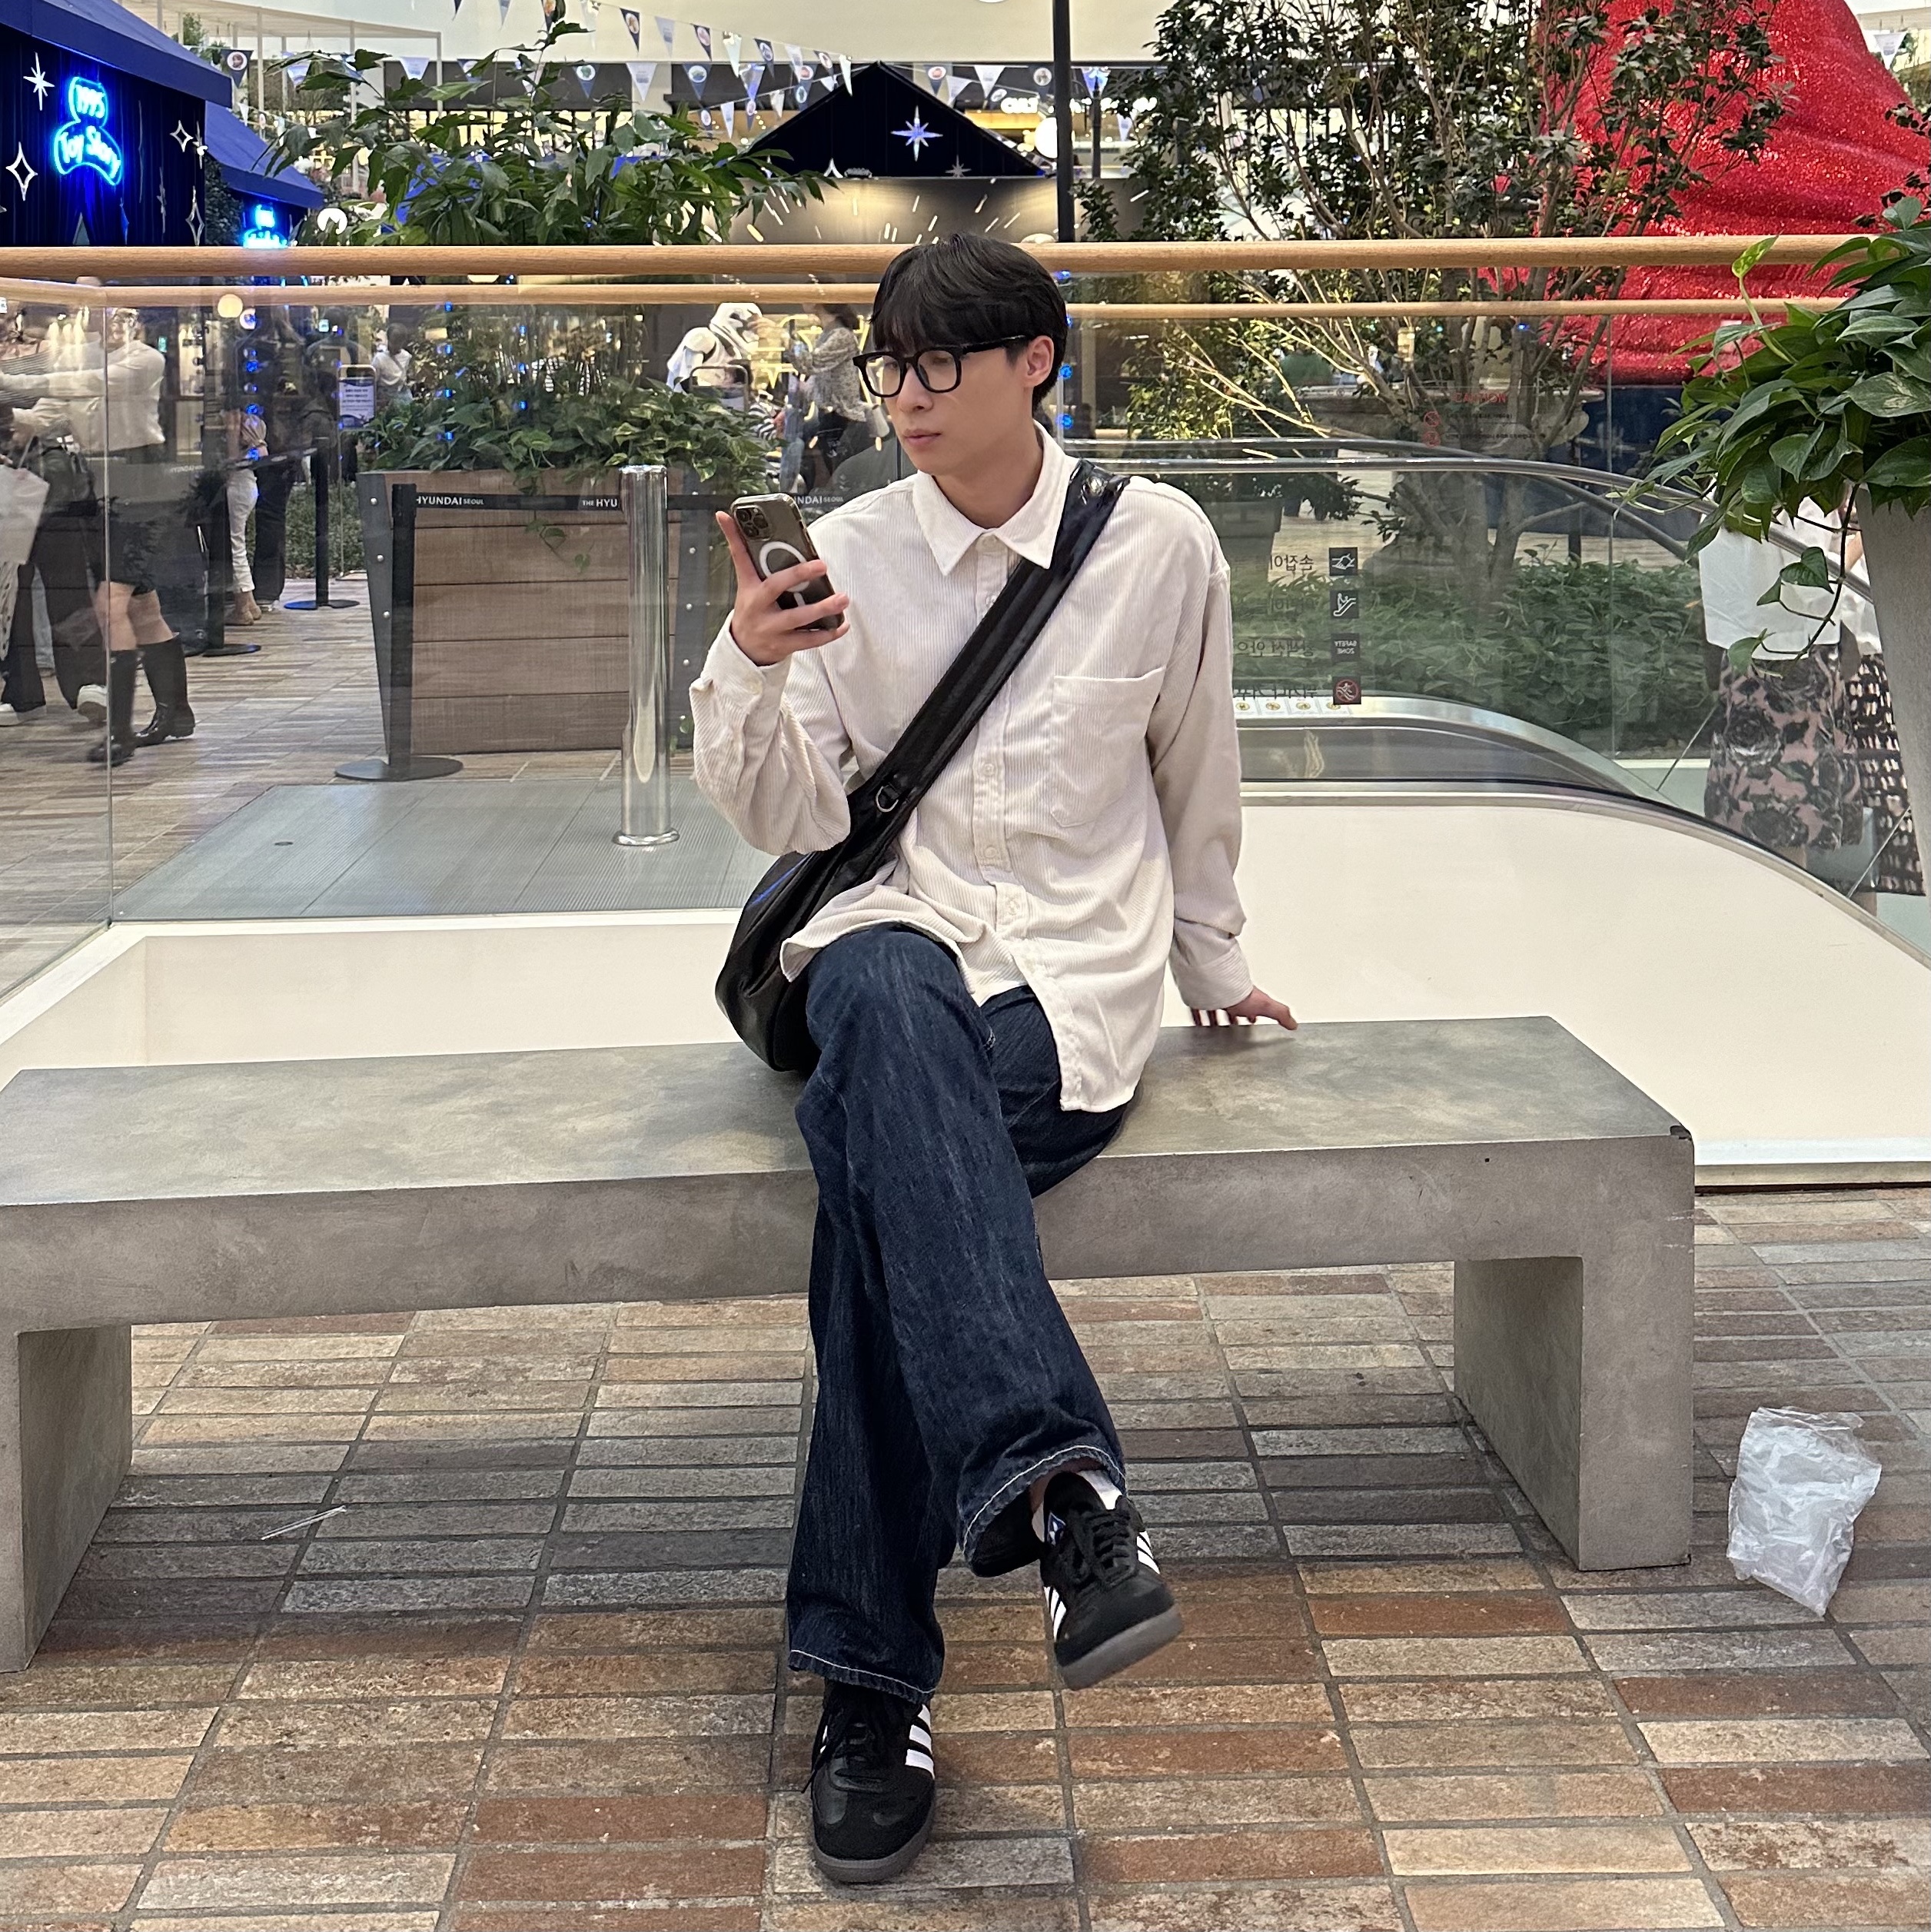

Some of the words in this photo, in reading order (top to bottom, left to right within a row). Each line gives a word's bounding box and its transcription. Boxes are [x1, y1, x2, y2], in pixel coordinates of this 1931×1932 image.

[60, 131, 85, 164] Toy
[86, 125, 121, 179] Story
[1452, 393, 1507, 403] CAUTION
[596, 498, 618, 507] HYU
[795, 496, 823, 504] NDAI
